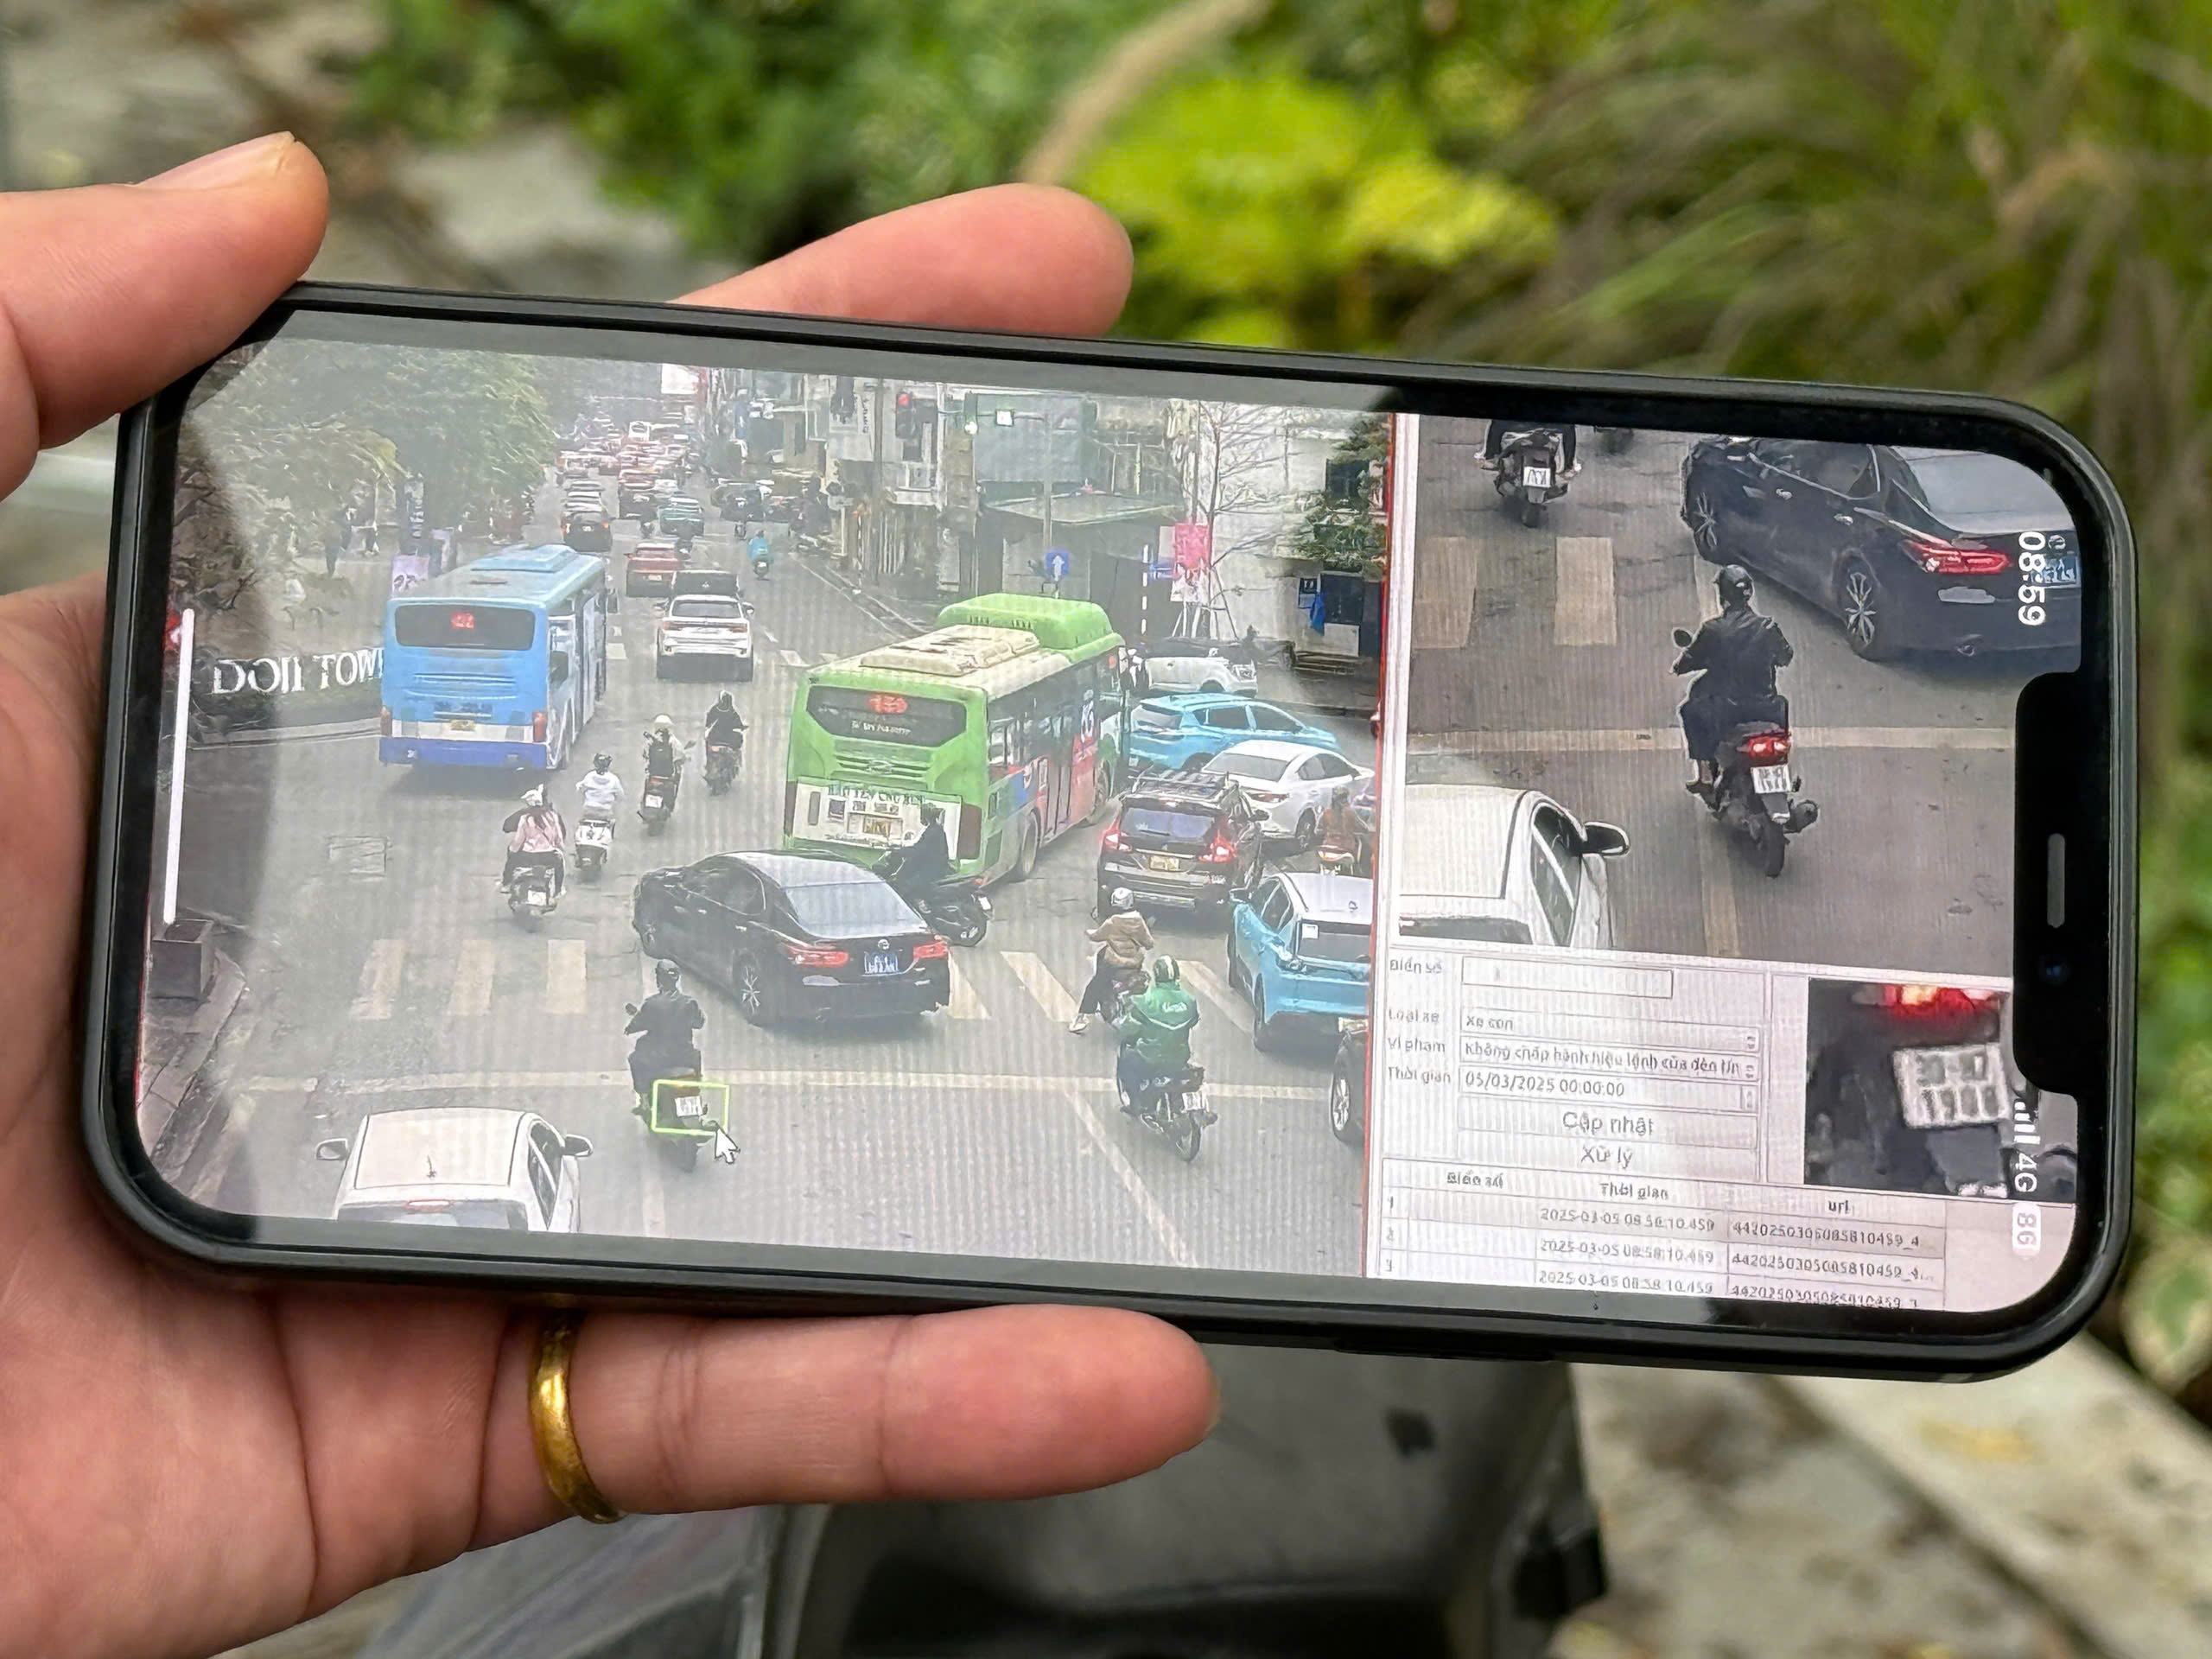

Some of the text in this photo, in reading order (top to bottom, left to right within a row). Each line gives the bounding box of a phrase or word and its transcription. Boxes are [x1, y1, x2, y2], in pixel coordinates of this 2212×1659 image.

[2018, 531, 2046, 626] 08:59
[312, 648, 385, 690] TOW
[1465, 1071, 1625, 1096] 05/03/2025 00:00:00
[1562, 1111, 1655, 1136] Cập nhật
[2015, 1152, 2037, 1193] 4G
[1827, 1199, 1849, 1211] url
